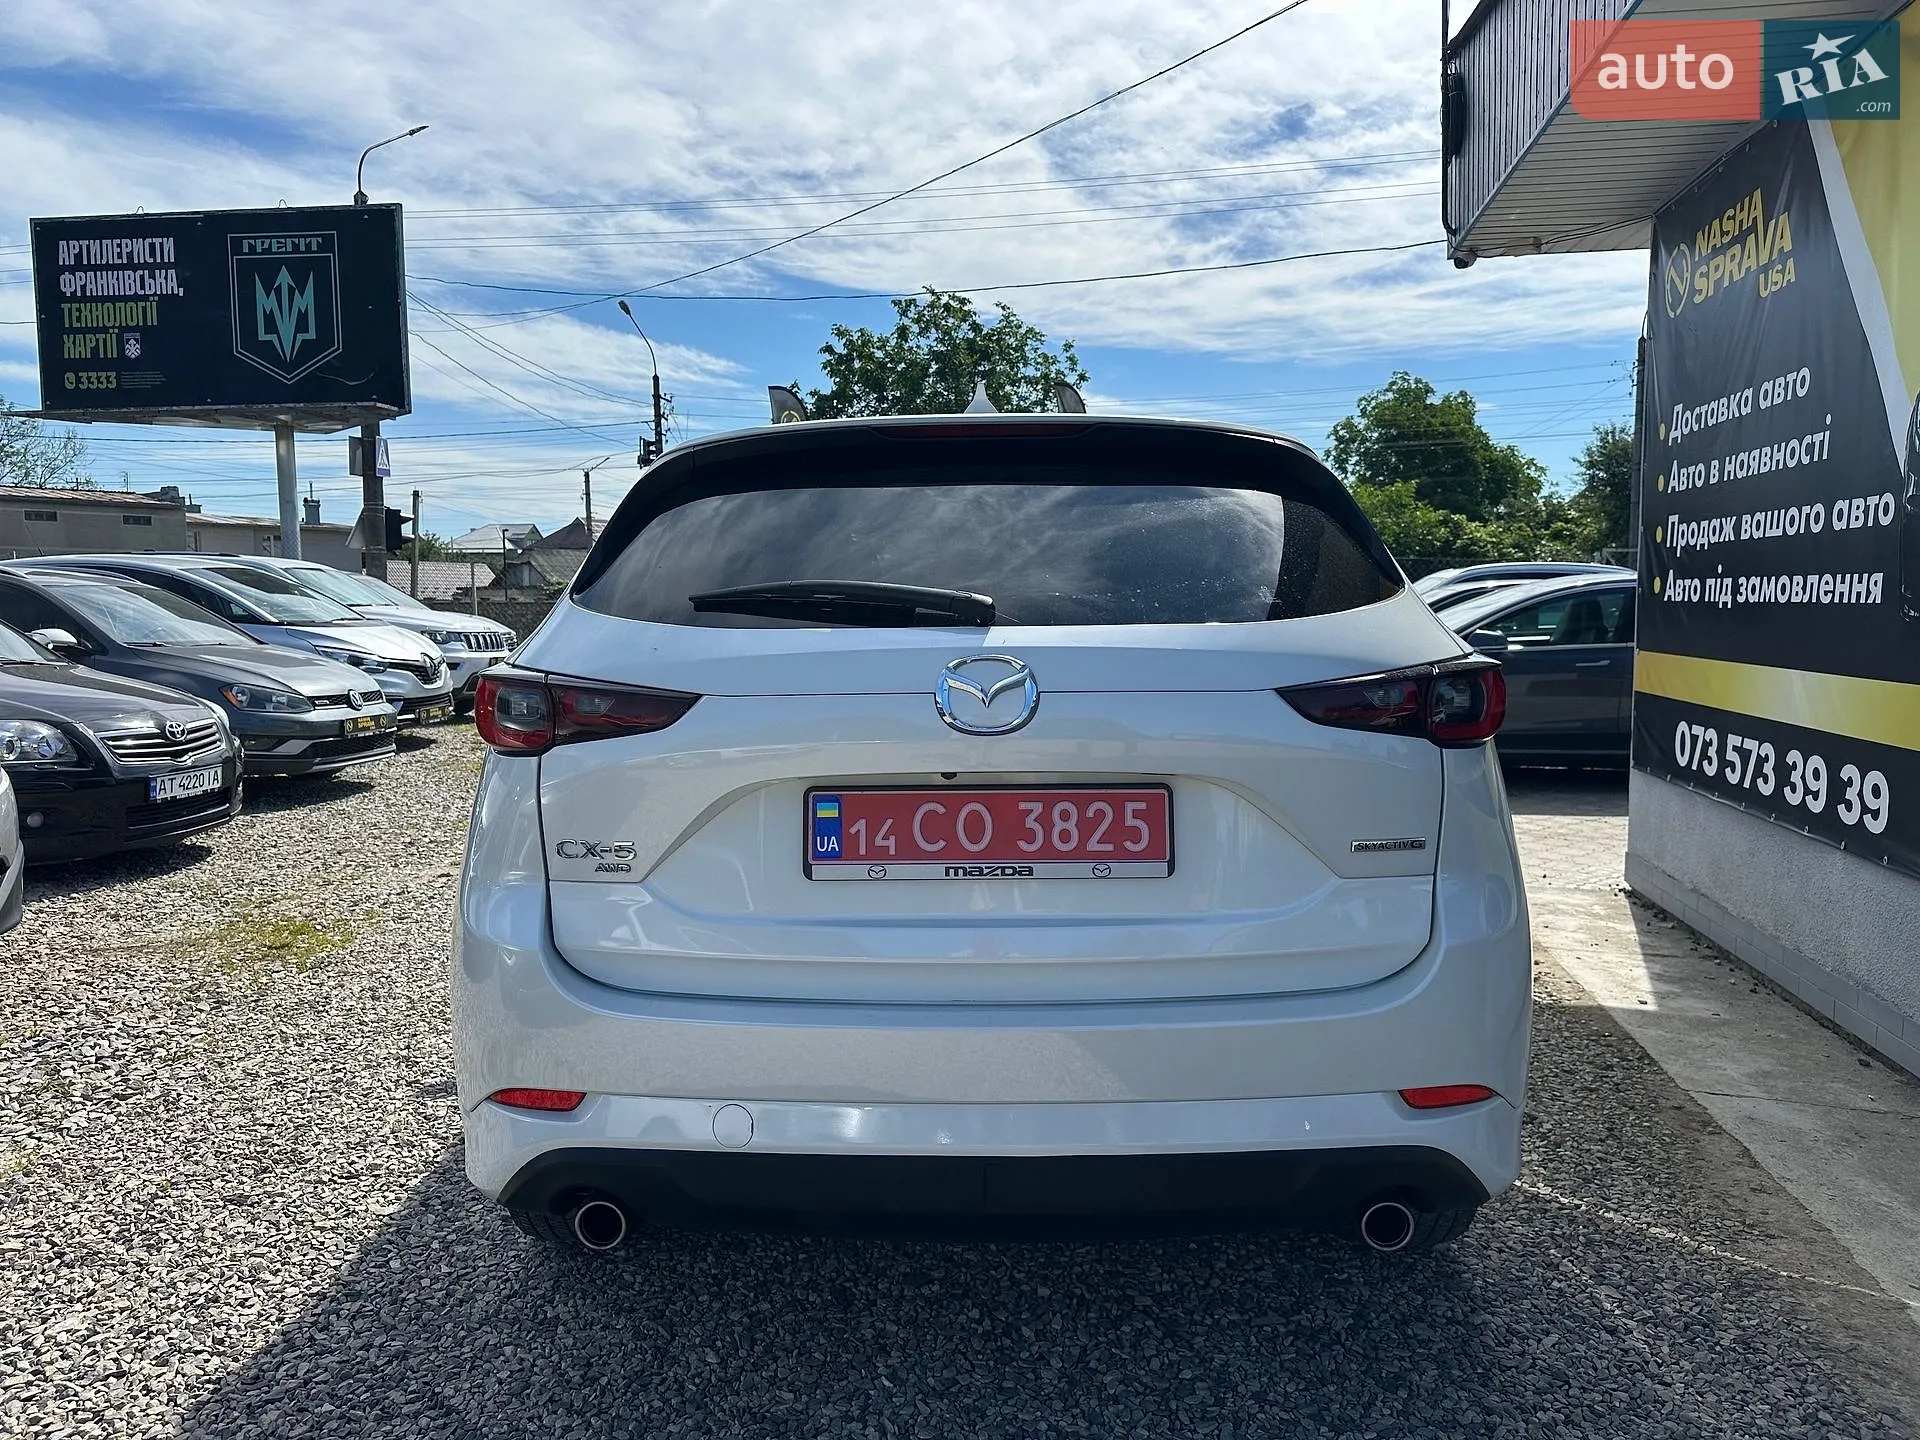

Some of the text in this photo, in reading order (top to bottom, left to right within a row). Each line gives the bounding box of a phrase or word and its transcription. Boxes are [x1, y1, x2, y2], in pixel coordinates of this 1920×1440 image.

[1695, 187, 1763, 262] NASHA
[58, 237, 175, 265] АРТИЛЕРИСТИ
[1693, 211, 1792, 303] SPRAVA
[59, 269, 184, 297] ФРАНКІВСЬКА,
[1759, 257, 1796, 298] USA
[61, 296, 159, 328] ТЕХНОЛОГІЇ
[63, 328, 119, 359] ХАРТІЇ
[78, 371, 117, 389] 3333
[1668, 366, 1811, 446] Доставка авто
[1667, 413, 1832, 494] Авто в наявності
[1666, 492, 1896, 557] Продаж вашого авто
[1663, 563, 1884, 609] Авто під замовлення
[158, 776, 176, 795] AT
[178, 772, 205, 791] 4220
[207, 769, 220, 787] IA
[1674, 721, 1890, 834] 073 573 39 39
[816, 836, 839, 852] UA
[849, 801, 1150, 855] 14 CO 3825
[555, 838, 637, 861] CX-5
[595, 863, 632, 873] AWD
